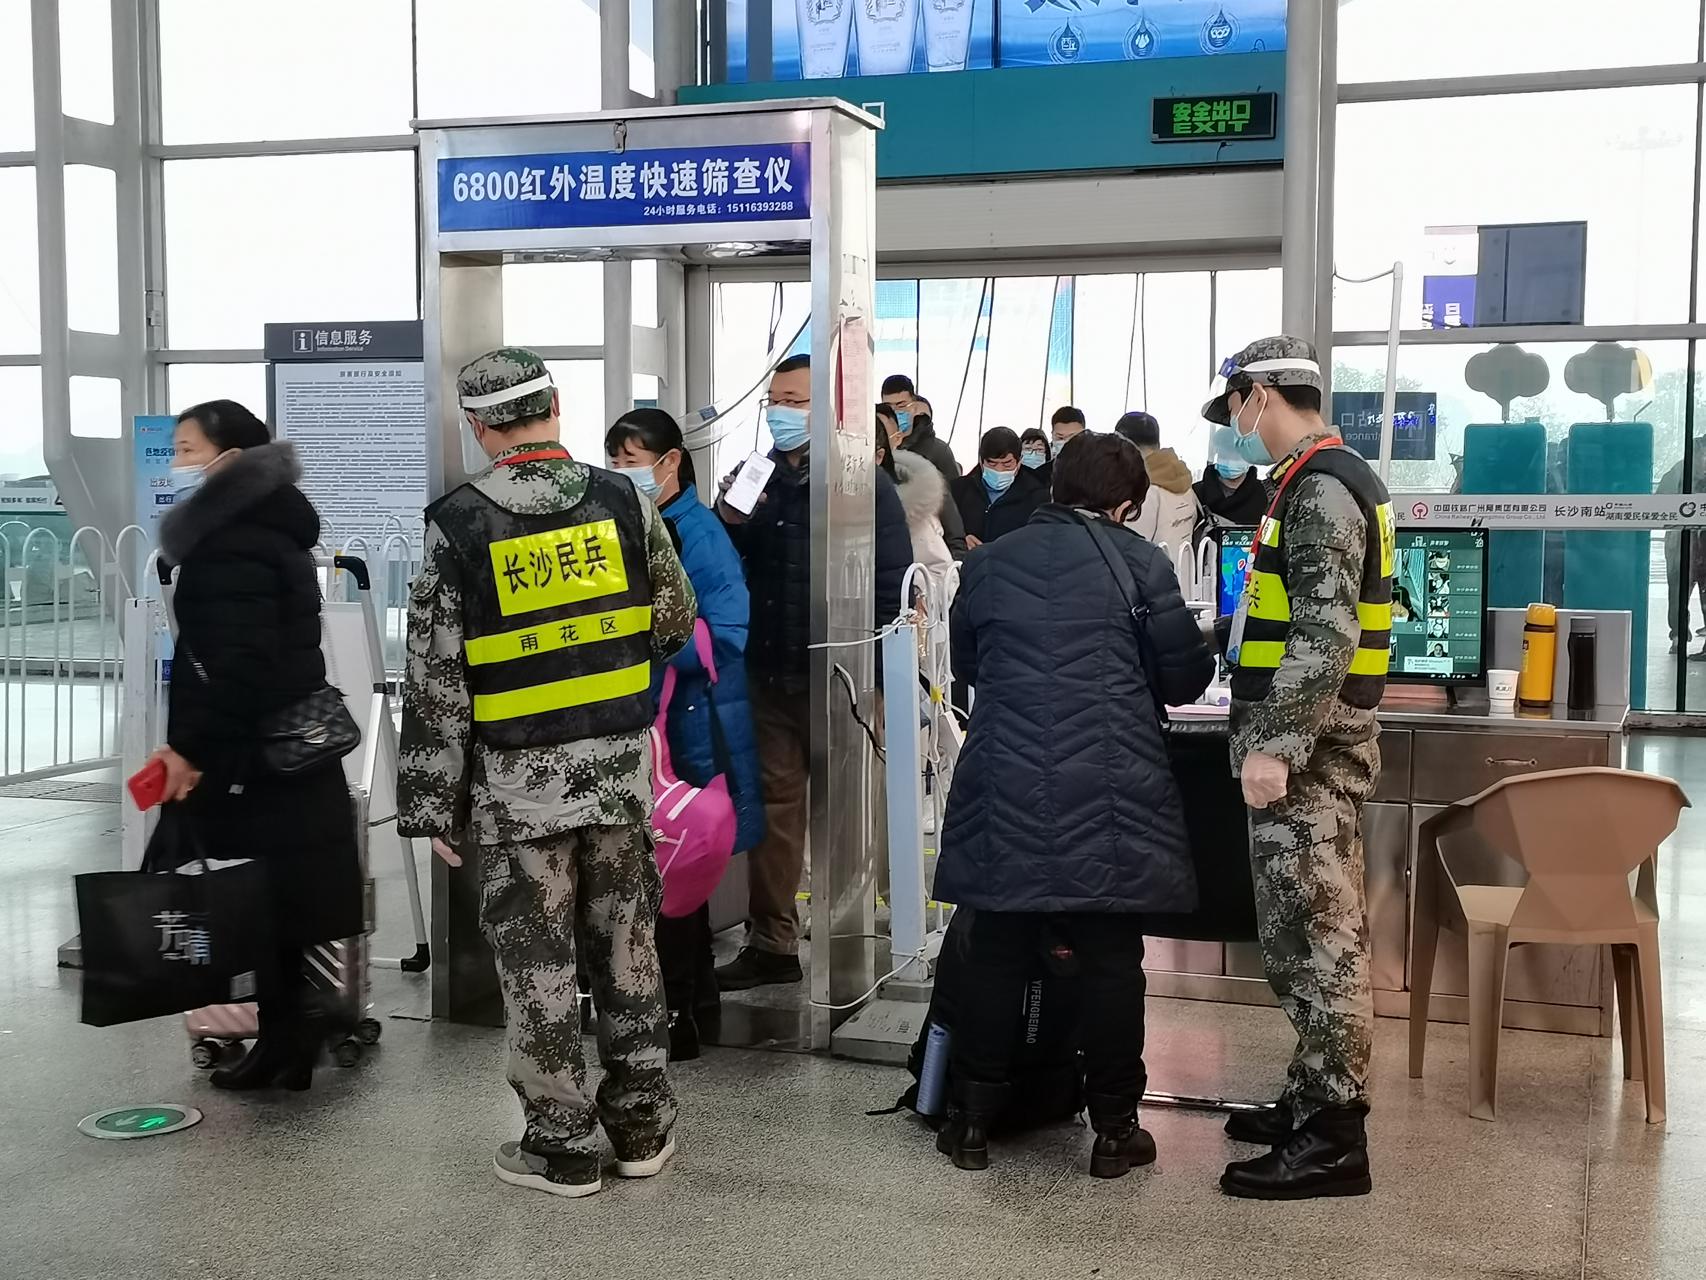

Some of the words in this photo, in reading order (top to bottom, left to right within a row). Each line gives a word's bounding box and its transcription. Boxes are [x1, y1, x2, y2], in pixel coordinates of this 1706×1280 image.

[1173, 100, 1250, 121] 安全出口
[1173, 121, 1249, 134] EXIT
[453, 156, 793, 202] 6800红外温度快速筛查仪
[315, 329, 373, 345] 信息服务
[1555, 505, 1606, 517] 长沙南站
[503, 536, 609, 595] 长沙民兵
[519, 616, 619, 652] 雨花区
[1026, 980, 1042, 1044] YIFENGBEIBAO
